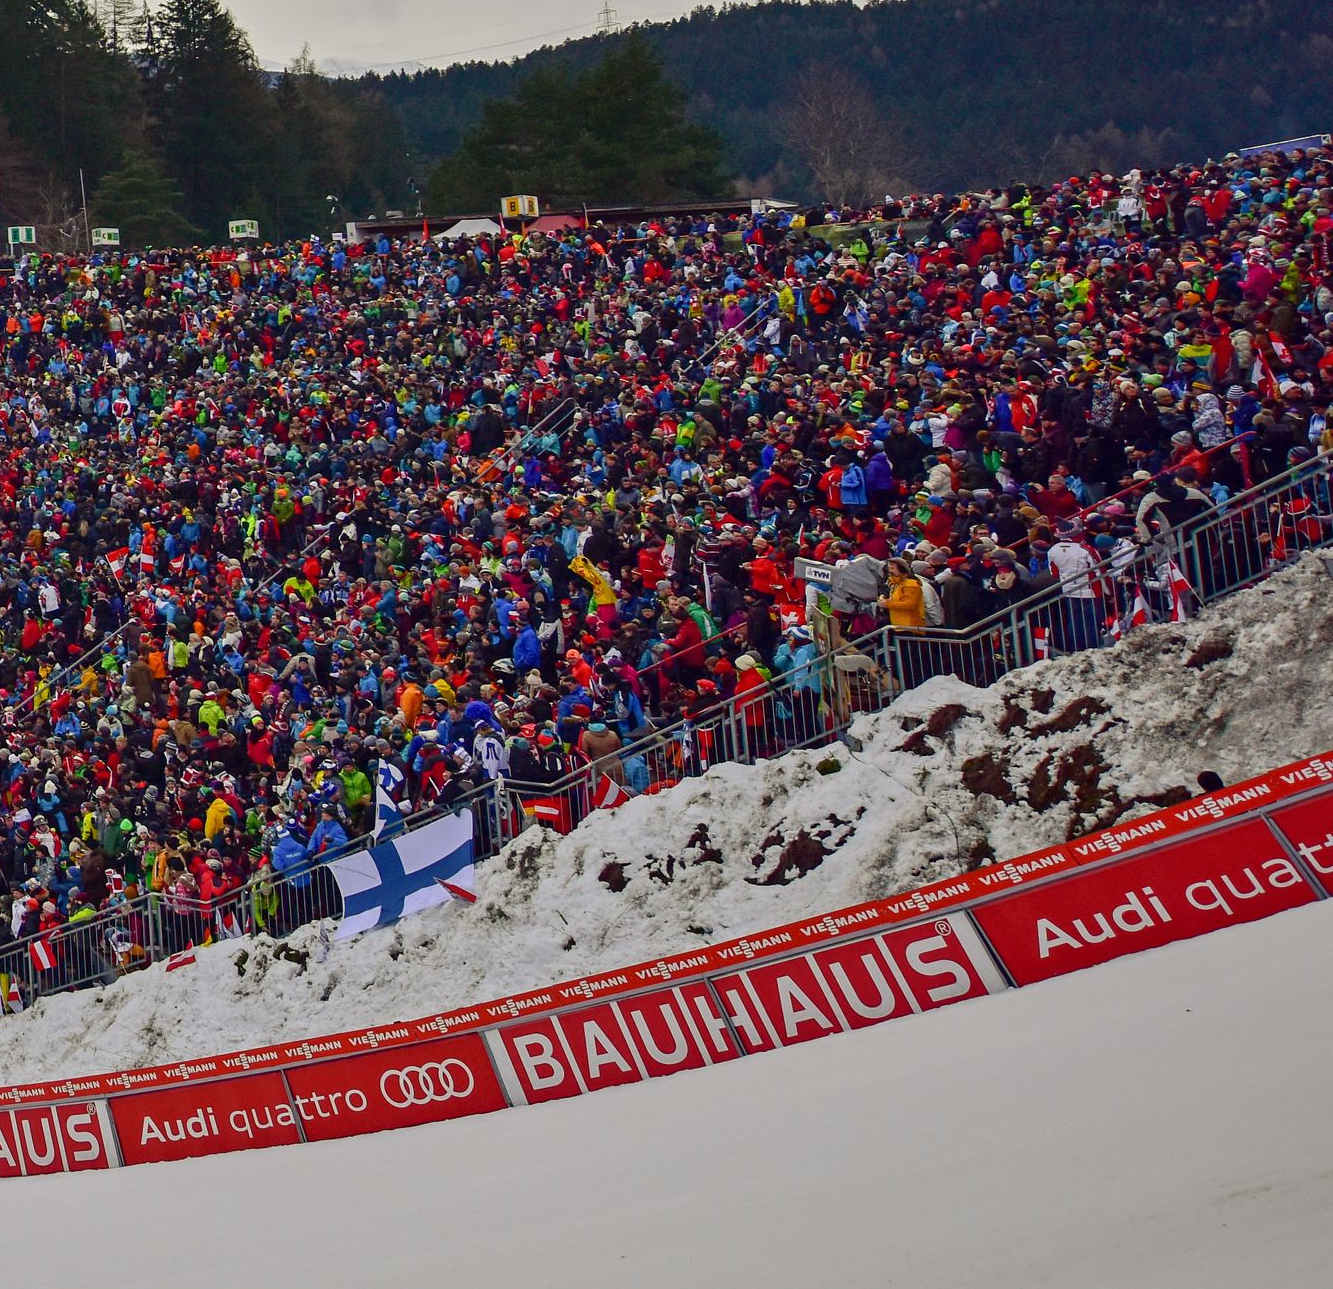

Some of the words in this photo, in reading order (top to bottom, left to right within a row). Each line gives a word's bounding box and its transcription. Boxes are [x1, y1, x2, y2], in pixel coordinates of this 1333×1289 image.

[813, 571, 830, 579] TVN
[1175, 784, 1271, 821] VIESSMANN
[1075, 819, 1166, 856] VIESSMANN
[978, 852, 1065, 886] VIESSMANN
[887, 882, 970, 912] VIESSMANN
[800, 908, 879, 935] VIESSMANN
[1036, 886, 1172, 959] Audi
[717, 933, 792, 959] VIESSMANN
[635, 955, 709, 980] VIESSMANN
[559, 975, 628, 998] VIESSMANN
[487, 994, 551, 1016] VIESSMANN
[513, 936, 971, 1091] BAUHAUS
[417, 1012, 479, 1033] VIESSMANN
[285, 1041, 342, 1059] VIESSMANN
[349, 1028, 409, 1048] VIESSMANN
[163, 1063, 216, 1079] VIESSMANN
[223, 1051, 278, 1069] VIESSMANN
[51, 1081, 100, 1096] VIESSMANN
[106, 1073, 157, 1089] VIESSMANN
[140, 1107, 219, 1145] Audi
[229, 1088, 367, 1138] quattro
